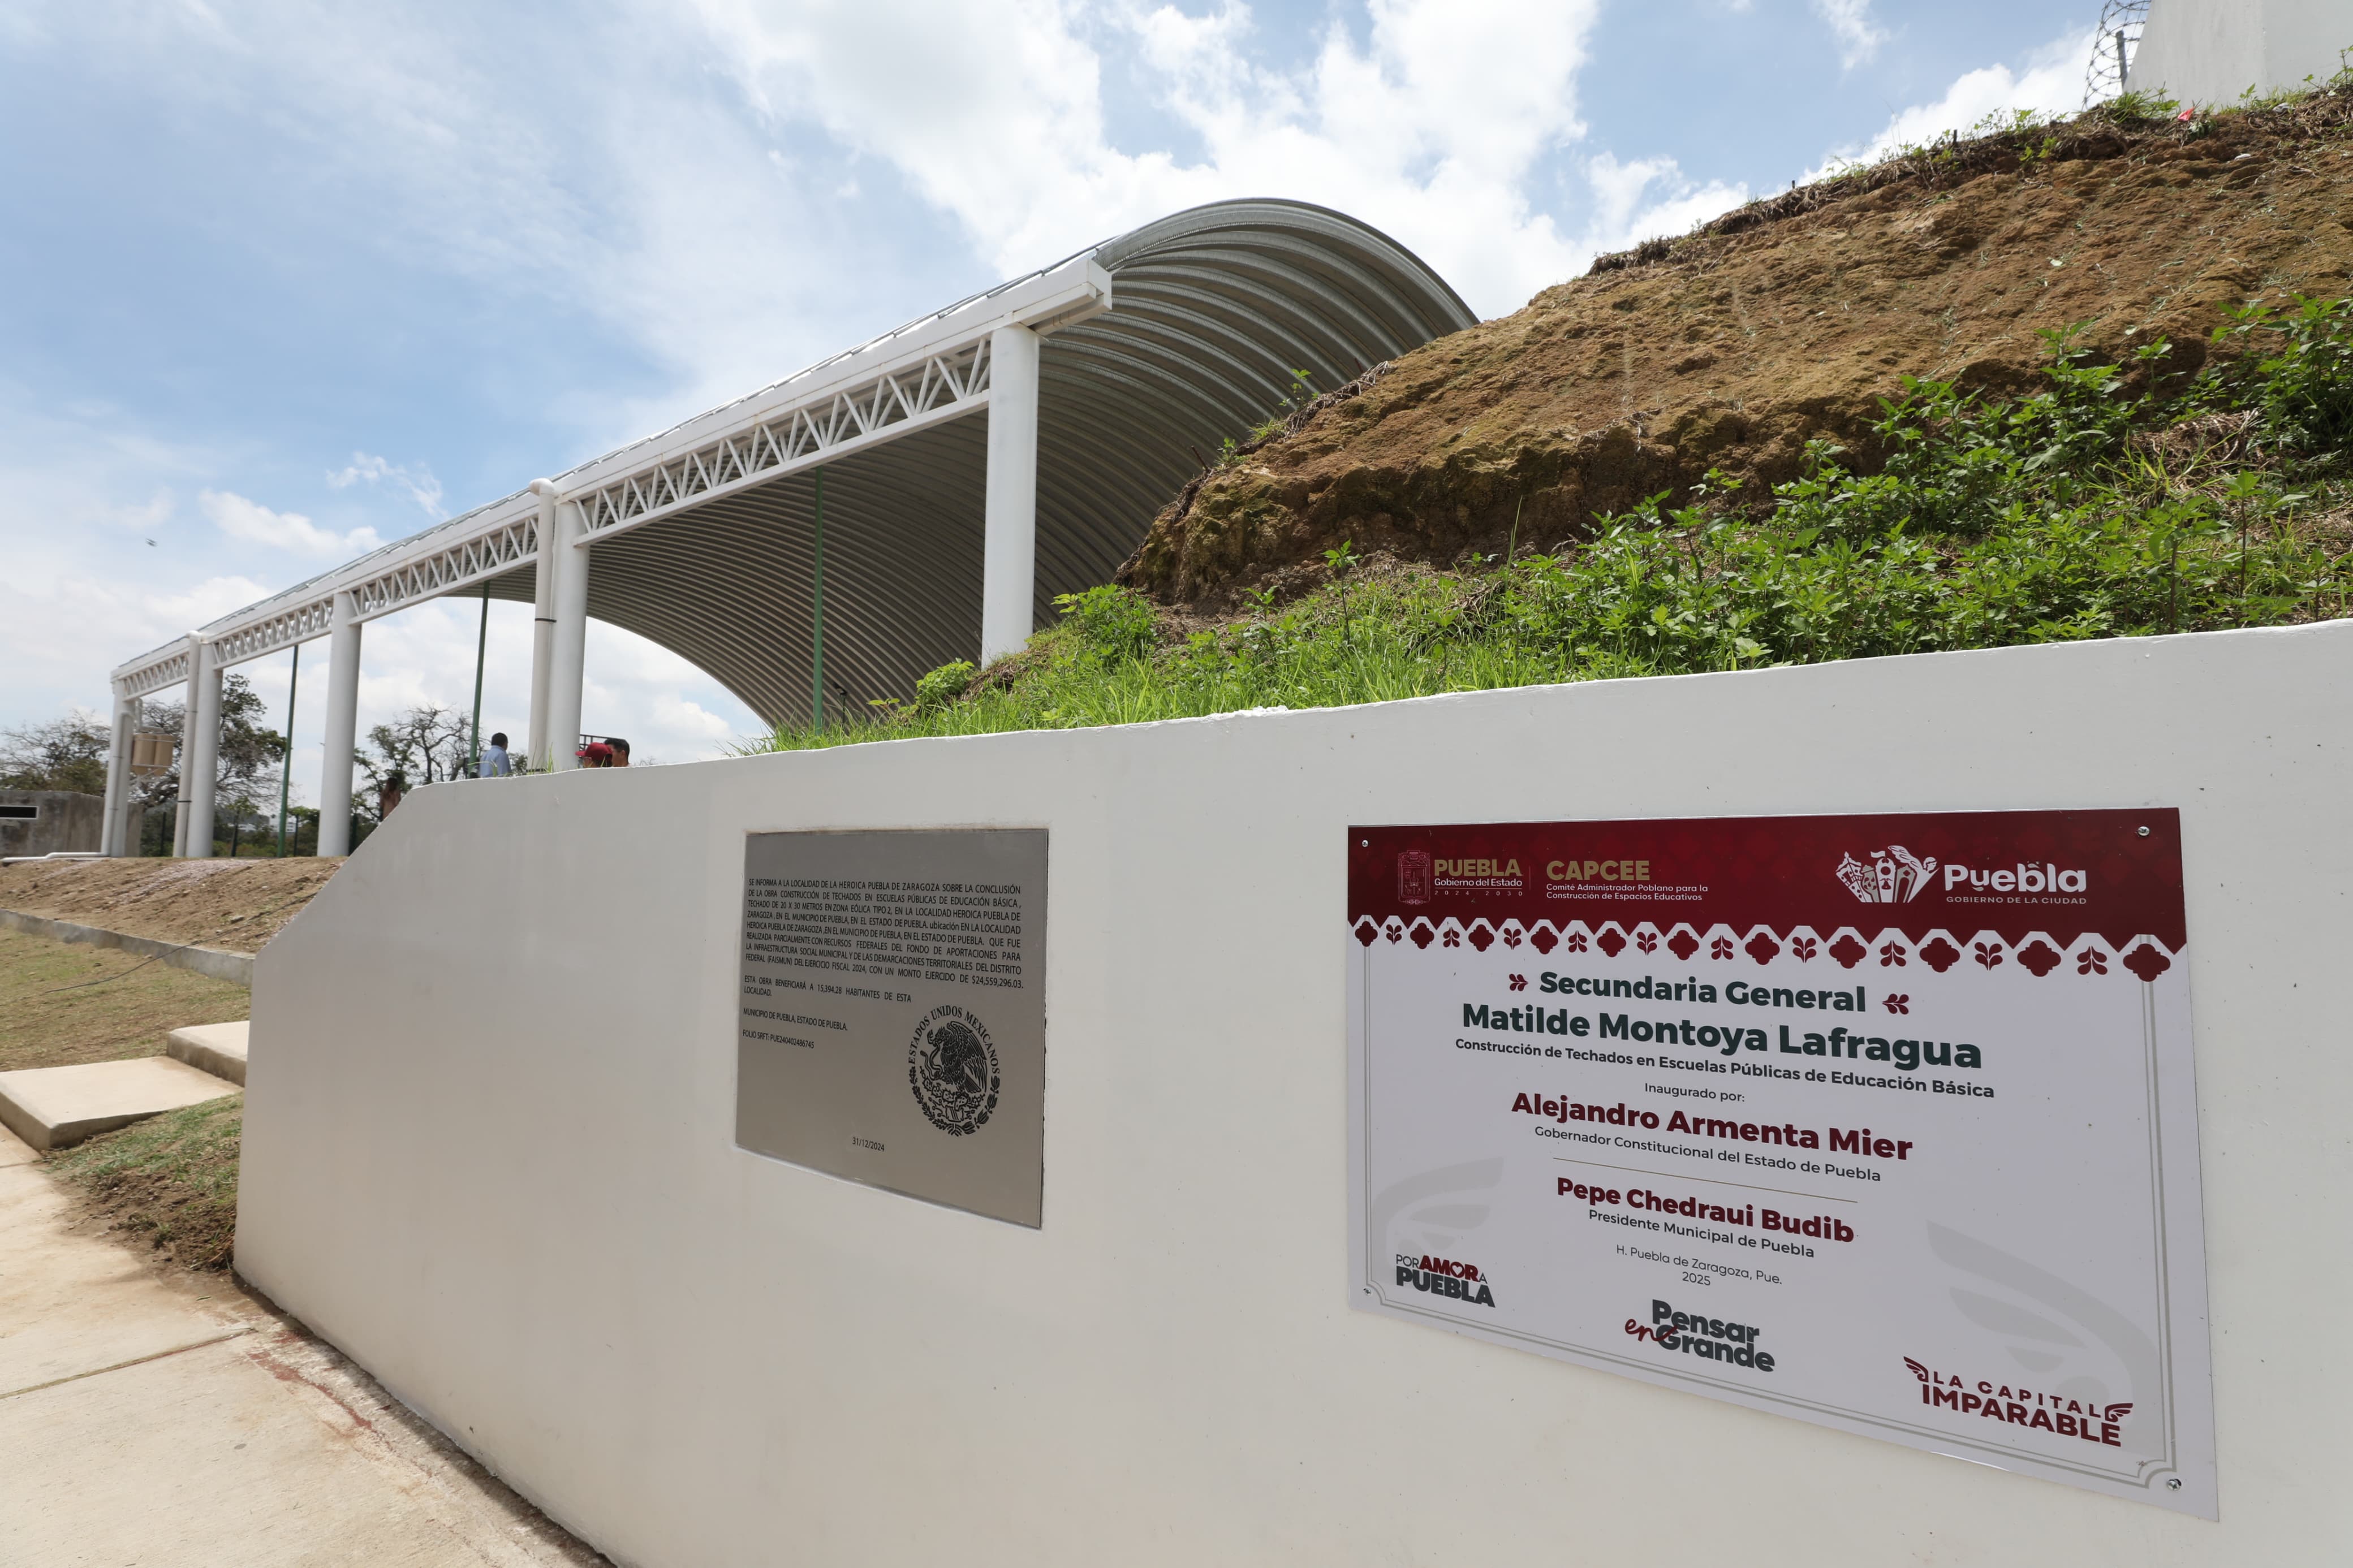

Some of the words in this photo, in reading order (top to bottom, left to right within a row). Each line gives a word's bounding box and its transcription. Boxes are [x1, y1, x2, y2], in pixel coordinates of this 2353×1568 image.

[1435, 859, 1522, 876] PUEBLA
[1547, 861, 1649, 880] CAPCEE
[1945, 863, 2086, 892] Puebla
[781, 890, 819, 899] CONSTRUCCIÓN
[832, 892, 861, 901] TECHADOS
[865, 893, 872, 901] EN
[877, 893, 905, 902] ESCUELAS
[907, 894, 937, 904] PÚBLICAS
[939, 896, 948, 905] DE
[950, 896, 990, 907] EDUCACIÓN
[791, 879, 820, 888] LOCALIDAD
[839, 881, 866, 889] HEROICA
[868, 882, 890, 891] PUEBLA
[891, 882, 900, 891] DE
[902, 883, 940, 892] ZARAGOZA
[942, 883, 963, 893] SOBRE
[964, 884, 973, 893] LA
[975, 883, 1020, 894] CONCLUSIÓN
[747, 932, 772, 941] REALIZADA
[774, 934, 811, 944] PARCIALMENTE
[811, 936, 823, 945] CON
[824, 937, 851, 948] RECURSOS
[856, 940, 887, 951] FEDERALES
[891, 943, 903, 952] DEL
[907, 944, 929, 954] FONDO
[933, 946, 942, 955] DE
[946, 947, 997, 960] APORTACIONES
[1002, 951, 1020, 961] PARA
[753, 943, 798, 954] INFRAESTRUCTURA
[800, 947, 817, 956] SOCIAL
[819, 949, 847, 960] MUNICIPAL
[854, 952, 861, 960] DE
[863, 952, 873, 961] LAS
[874, 953, 925, 966] DEMARCACIONES
[926, 958, 973, 970] TERRITORIALES
[976, 962, 989, 972] DEL
[990, 964, 1022, 975] DISTRITO
[745, 953, 765, 962] FEDERAL
[767, 955, 792, 966] (FAISMUN)
[794, 958, 804, 966] DEL
[805, 958, 830, 969] EJERCICIO
[832, 961, 850, 971] FISCAL
[869, 965, 882, 974] CON
[885, 967, 894, 976] UN
[898, 968, 921, 979] MONTO
[925, 970, 955, 982] EJERCIDO
[960, 974, 968, 983] DE
[745, 975, 756, 983] ESTA
[759, 977, 772, 986] OBRA
[775, 978, 806, 990] BENEFICIARÁ
[817, 984, 842, 995] 15,394.28
[846, 987, 880, 999] HABITANTES
[884, 992, 893, 1000] DE
[897, 993, 911, 1003] ESTA
[1540, 972, 1717, 1003] Secundaria
[1726, 982, 1865, 1012] General
[743, 1008, 768, 1018] MUNICIPIO
[769, 1011, 775, 1020] DE
[797, 1016, 817, 1026] ESTADO
[818, 1018, 825, 1027] DE
[742, 1029, 756, 1039] FOLIO
[757, 1031, 770, 1042] SRFT:
[908, 1016, 930, 1065] ESTADOS
[931, 1005, 962, 1020] UNIDOS
[964, 1011, 1001, 1074] MEXICANOS
[1464, 1004, 1590, 1036] Matilde
[1600, 1013, 1767, 1056] Montoya
[1779, 1025, 1981, 1070] Lafragua
[1456, 1039, 1541, 1056] Construcción
[1545, 1047, 1562, 1057] de
[1565, 1048, 1632, 1064] Techados
[1637, 1057, 1654, 1066] en
[1660, 1057, 1726, 1073] Escuelas
[1731, 1063, 1800, 1079] Públicas
[1805, 1069, 1826, 1082] de
[1832, 1072, 1926, 1091] Educación
[1933, 1080, 1994, 1098] Básica
[1645, 1083, 1716, 1099] Inaugurado
[1721, 1092, 1744, 1102] por:
[1512, 1093, 1659, 1129] Alejandro
[1666, 1111, 1818, 1149] Armenta
[1830, 1128, 1912, 1160] Mier
[852, 1137, 885, 1152] 31/12/2024
[1535, 1126, 1611, 1144] Gobernador
[1615, 1137, 1713, 1159] Constitucional
[1718, 1151, 1739, 1163] del
[1746, 1154, 1796, 1169] Estado
[1801, 1161, 1820, 1173] de
[1826, 1164, 1880, 1181] Puebla
[1558, 1177, 1621, 1206] Pepe
[1627, 1189, 1753, 1229] Chedraui
[1762, 1209, 1854, 1242] Budib
[1590, 1210, 1660, 1230] Presidente
[1665, 1223, 1733, 1243] Municipal
[1738, 1235, 1756, 1247] de
[1762, 1239, 1813, 1257] Puebla
[1617, 1245, 1627, 1255] H.
[1630, 1246, 1670, 1264] Puebla
[1673, 1254, 1690, 1267] de
[1692, 1259, 1752, 1280] Zaragoza,
[1757, 1270, 1782, 1284] Pue.
[1683, 1272, 1710, 1285] 2025
[1396, 1266, 1496, 1308] PUEBLA
[1652, 1299, 1760, 1344] Pensar
[1624, 1318, 1678, 1342] en
[1656, 1324, 1775, 1372] Grande
[1933, 1371, 1964, 1389] LA
[1977, 1380, 2101, 1419] CAPITAL
[1923, 1384, 2121, 1448] IMPARABLE
